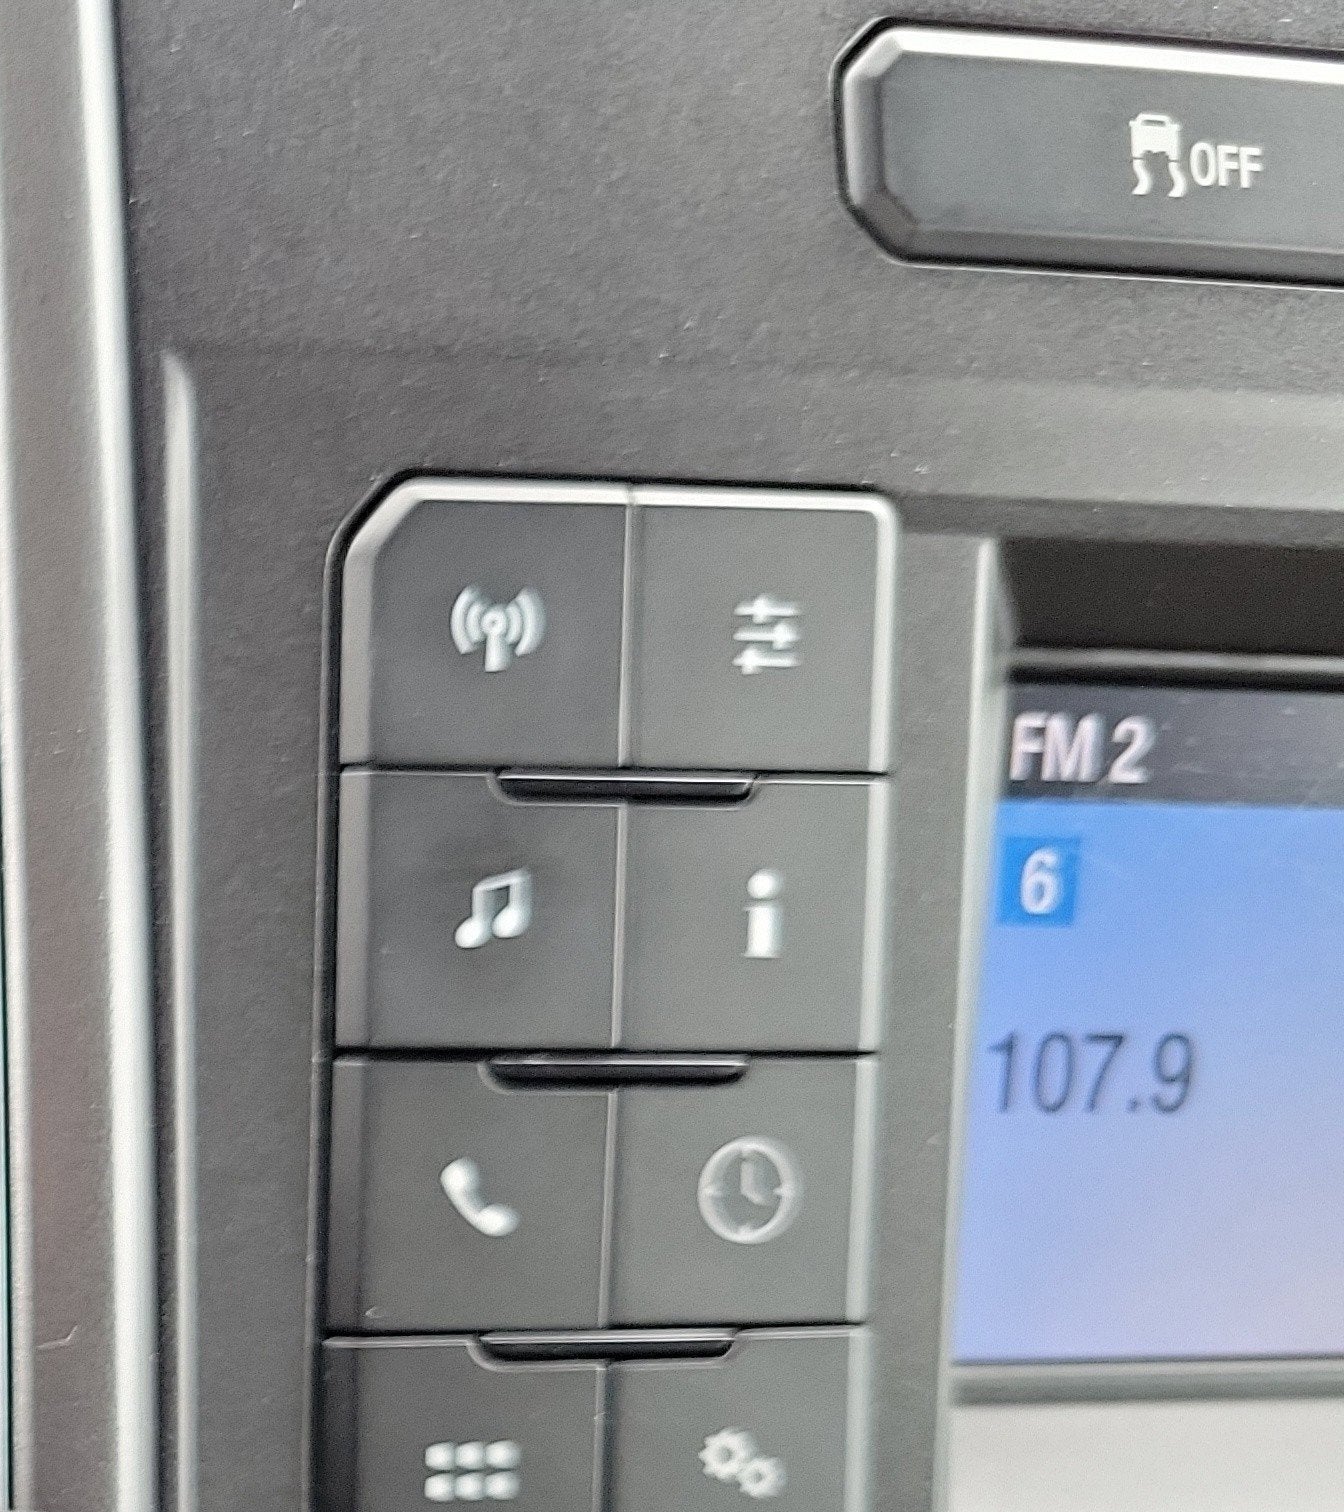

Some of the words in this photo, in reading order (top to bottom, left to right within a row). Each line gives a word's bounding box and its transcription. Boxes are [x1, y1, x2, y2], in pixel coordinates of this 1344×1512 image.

[1189, 141, 1264, 189] OFF
[1009, 711, 1108, 783] FM
[1107, 714, 1157, 784] 2
[1019, 846, 1064, 916] 6
[987, 1030, 1198, 1115] 107.9
